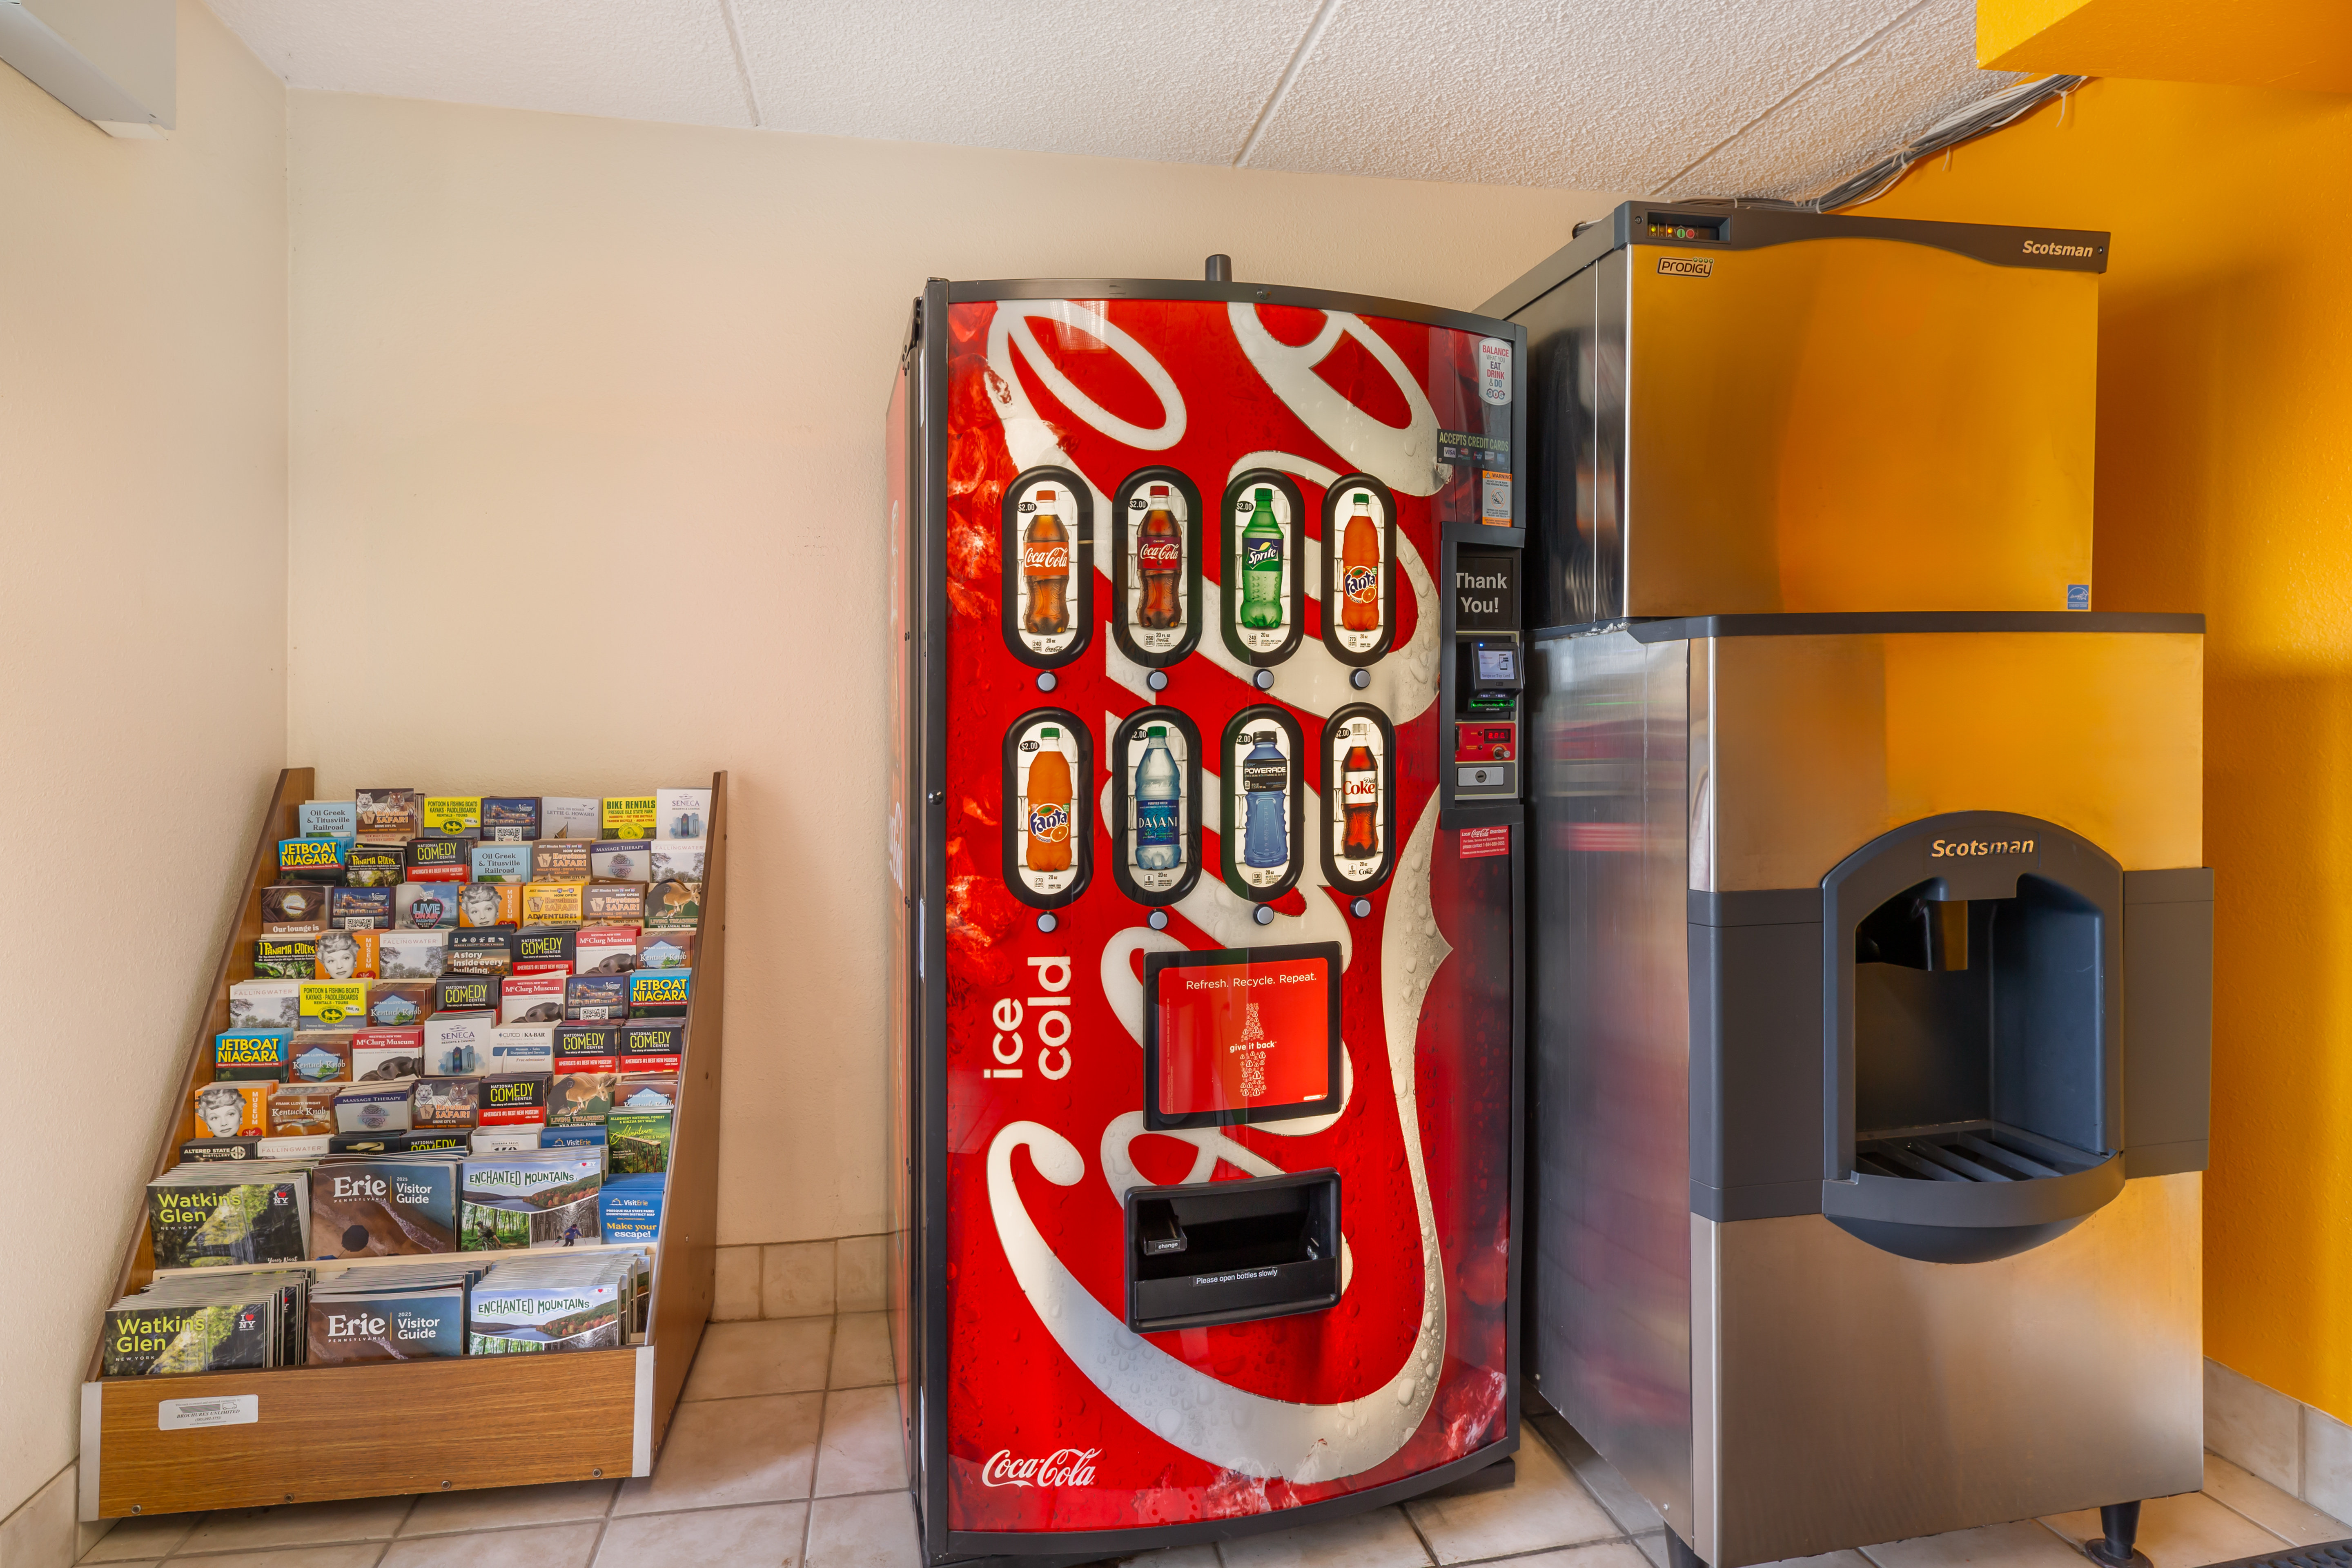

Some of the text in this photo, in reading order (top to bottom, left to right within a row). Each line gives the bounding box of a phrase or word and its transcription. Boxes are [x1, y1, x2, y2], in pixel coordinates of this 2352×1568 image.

[2022, 241, 2093, 257] Scotsman
[1483, 345, 1509, 357] BALANCE
[1487, 369, 1504, 380] DRINK
[1494, 379, 1502, 388] DO
[1439, 432, 1508, 452] ACCEPTS CREDIT CARDS
[1018, 503, 1035, 512] $2.00
[1024, 547, 1068, 568] Coca-Cola
[1140, 543, 1179, 560] Coca-Cola
[1248, 547, 1276, 565] Sprite
[1456, 573, 1507, 588] Thank
[1461, 597, 1499, 612] You!
[1021, 742, 1038, 750] $2.00
[1343, 780, 1375, 795] Coke
[606, 800, 655, 809] BIKE RENTALS
[1139, 814, 1177, 831] DASANI
[1471, 829, 1490, 837] Coca-Cola
[281, 842, 336, 855] JETBOAT
[1931, 840, 2034, 858] Scotsman
[282, 853, 338, 866] NIAGARA
[351, 855, 396, 865] PANAMA ROCKS
[413, 903, 440, 914] LIVE
[521, 938, 562, 955] COMEDY
[633, 979, 687, 991] JETBOAT
[1186, 972, 1316, 990] Refresh. Recycle. Repeat.
[633, 990, 687, 1002] NIAGARA
[1027, 956, 1071, 1080] cold
[441, 1031, 475, 1040] SENECA
[984, 998, 1023, 1078] ice
[1229, 1044, 1246, 1053] give
[292, 1061, 323, 1069] Kentuck
[470, 1170, 574, 1186] ENCHANTED MOUNTAINS
[333, 1175, 386, 1198] Erie
[396, 1183, 432, 1194] Visitor
[158, 1193, 241, 1207] Watkins
[396, 1194, 429, 1204] Guide
[160, 1209, 206, 1223] Glen
[615, 1231, 651, 1239] escape!
[1158, 1242, 1178, 1250] change
[1196, 1268, 1278, 1285] Please open bottles slowly
[479, 1298, 590, 1314] ENCHANTED MOUNTAINS
[117, 1316, 205, 1335] Watkins
[328, 1313, 385, 1337] Erie
[398, 1318, 440, 1329] Visitor
[397, 1329, 436, 1340] Guide
[116, 1337, 166, 1352] Glen
[982, 1448, 1102, 1488] Coca-Cola
